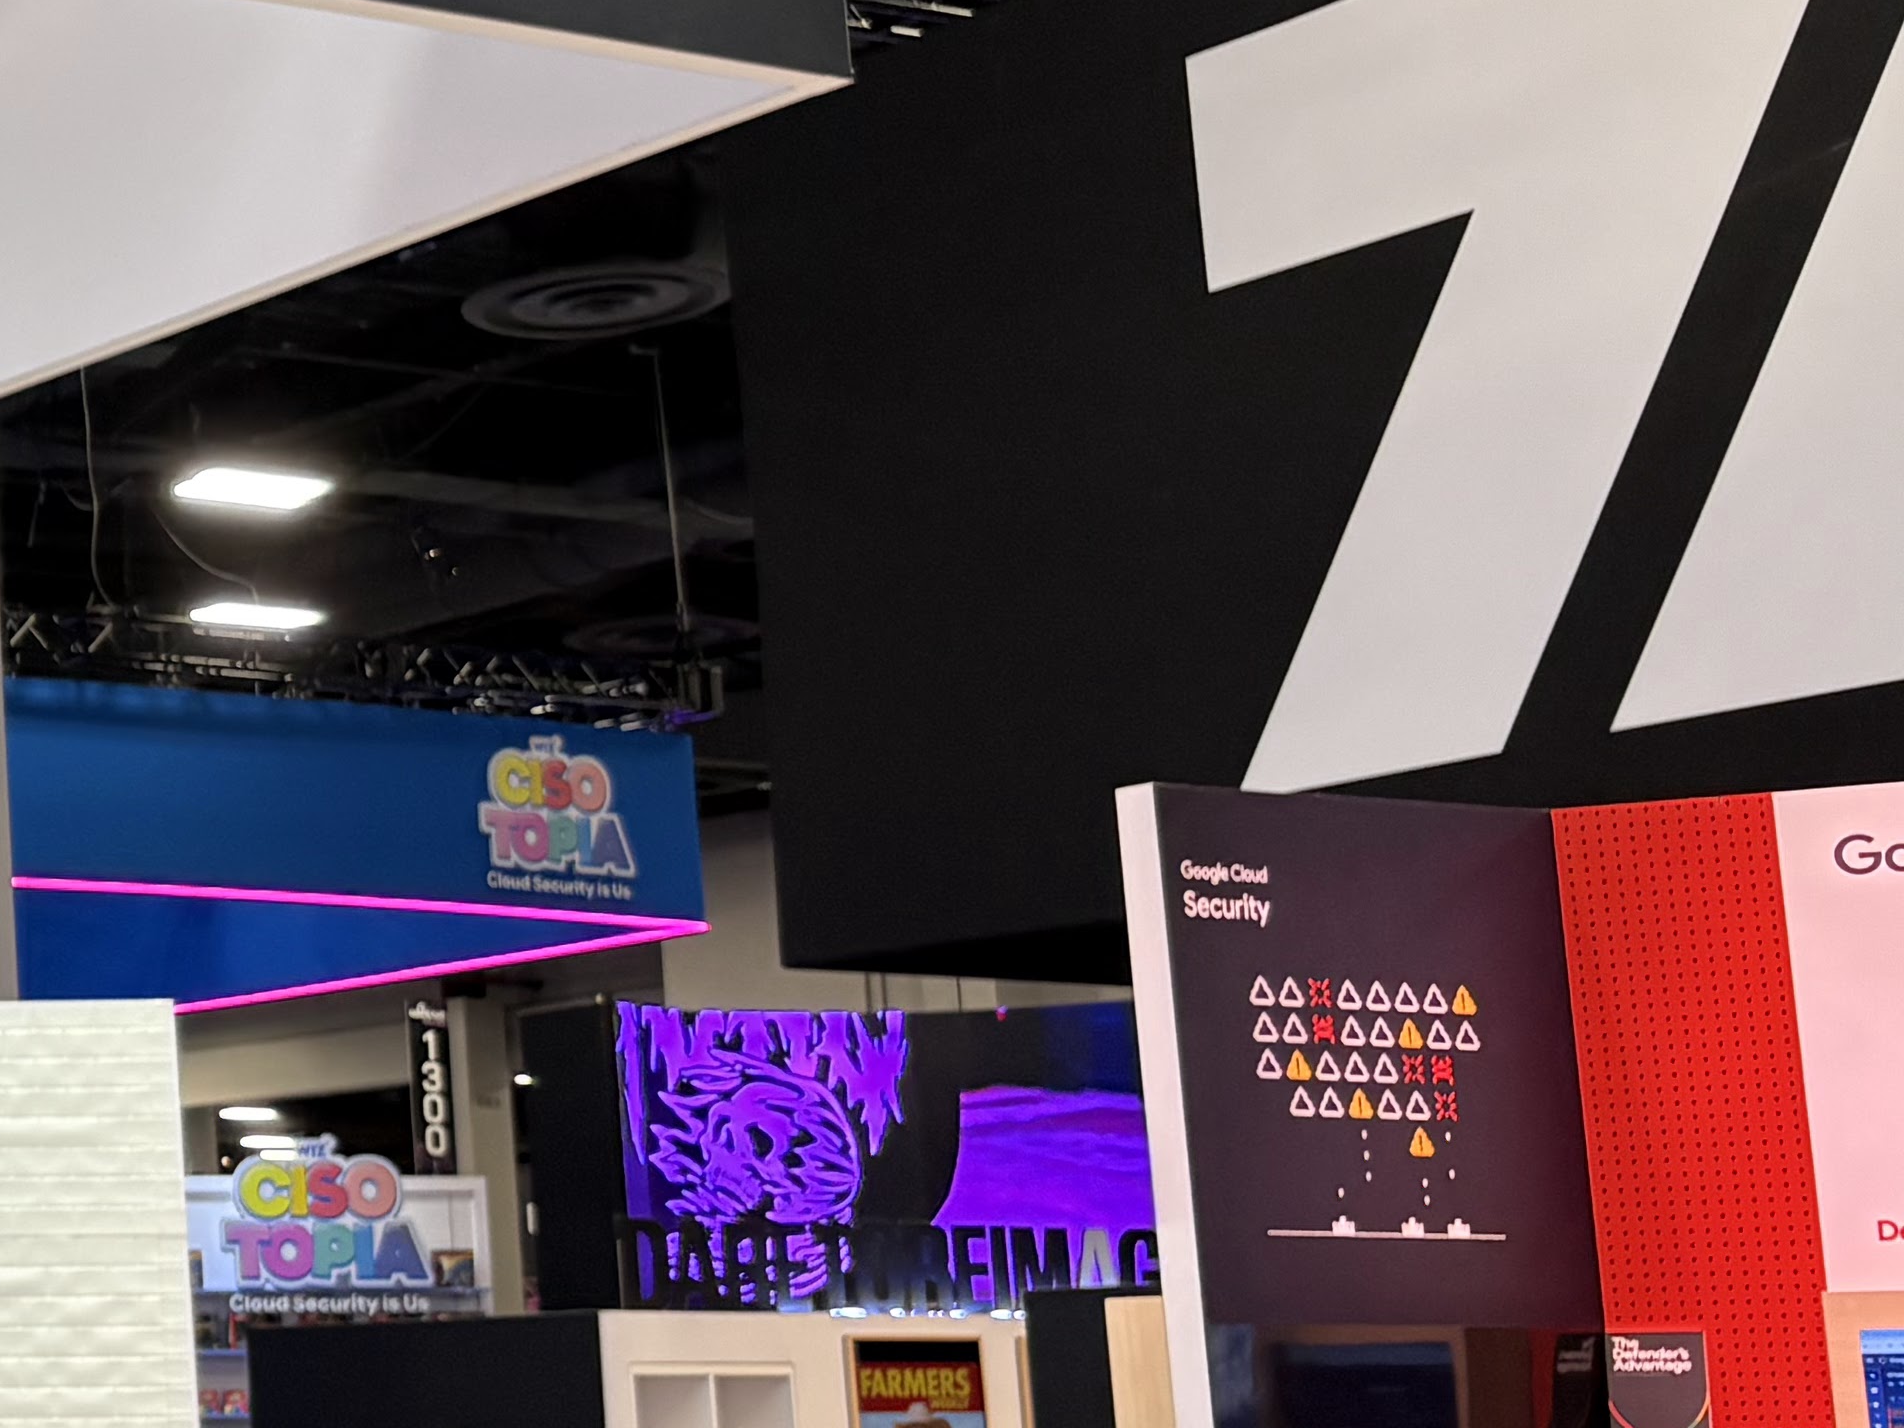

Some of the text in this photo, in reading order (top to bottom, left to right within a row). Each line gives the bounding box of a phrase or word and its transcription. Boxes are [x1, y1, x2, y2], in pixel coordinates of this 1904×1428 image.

[494, 752, 609, 814] CISO
[483, 808, 633, 871] TOPIA
[486, 871, 531, 893] Cloud
[532, 874, 594, 899] Security
[1180, 858, 1268, 886] Google Cloud
[1183, 889, 1270, 928] Security
[420, 1028, 449, 1158] 1300
[238, 1161, 398, 1220] CISO
[224, 1223, 430, 1280] TOPIA
[229, 1293, 291, 1314] Cloud
[293, 1293, 380, 1316] Security
[402, 1293, 431, 1314] Us
[1611, 1335, 1639, 1350] The
[1612, 1347, 1690, 1361] Defender's
[860, 1366, 972, 1399] FARMERS
[1613, 1359, 1692, 1375] Advantage
